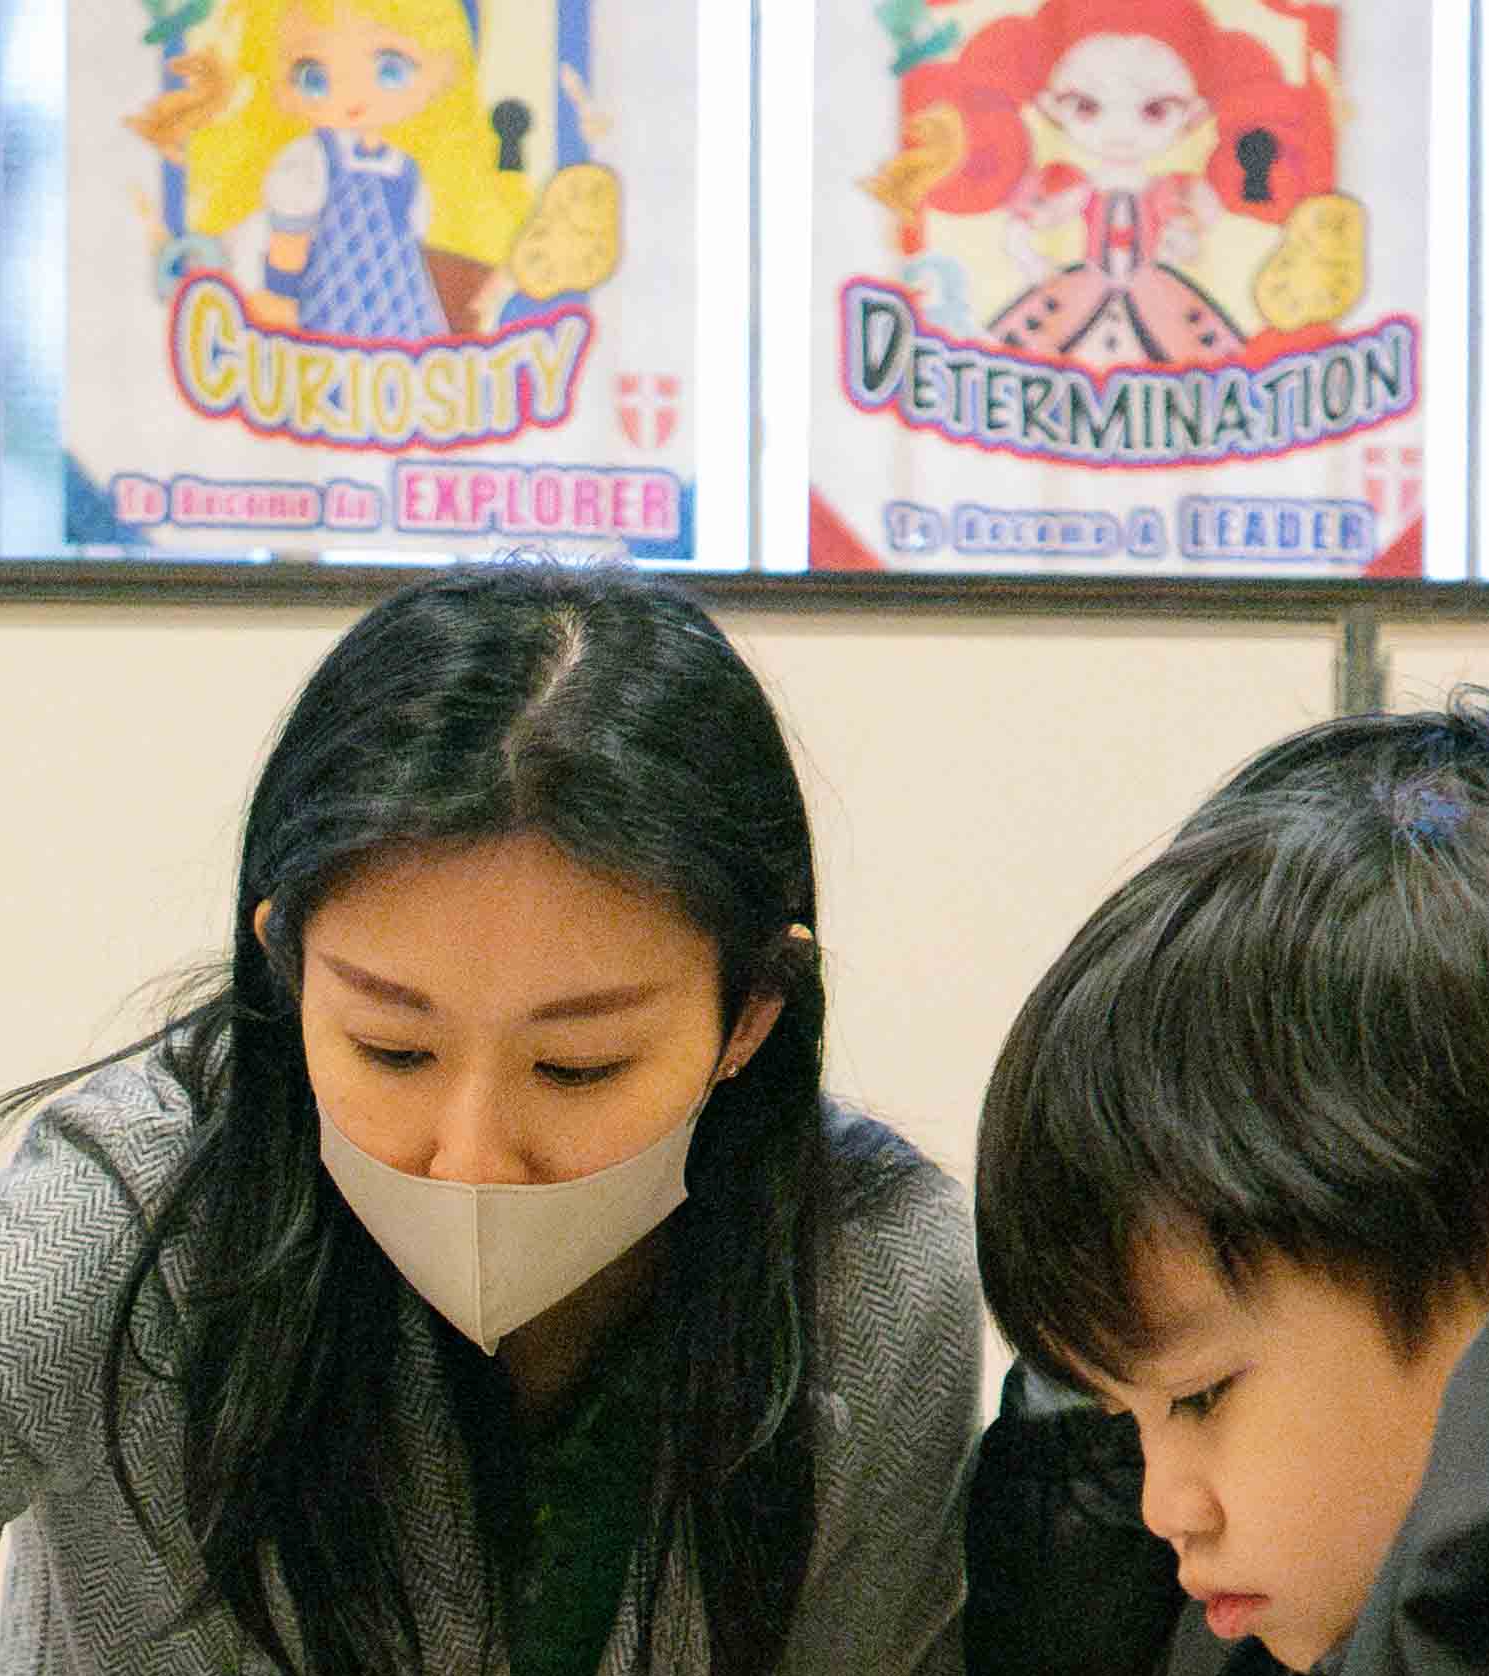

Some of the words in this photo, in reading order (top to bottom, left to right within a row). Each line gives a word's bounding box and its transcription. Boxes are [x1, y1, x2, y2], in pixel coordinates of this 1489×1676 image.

[188, 290, 576, 436] CURIOSITY
[859, 299, 1410, 452] DETERMINATION
[404, 474, 673, 530] EXPLORER
[1188, 508, 1364, 550] LEADER
